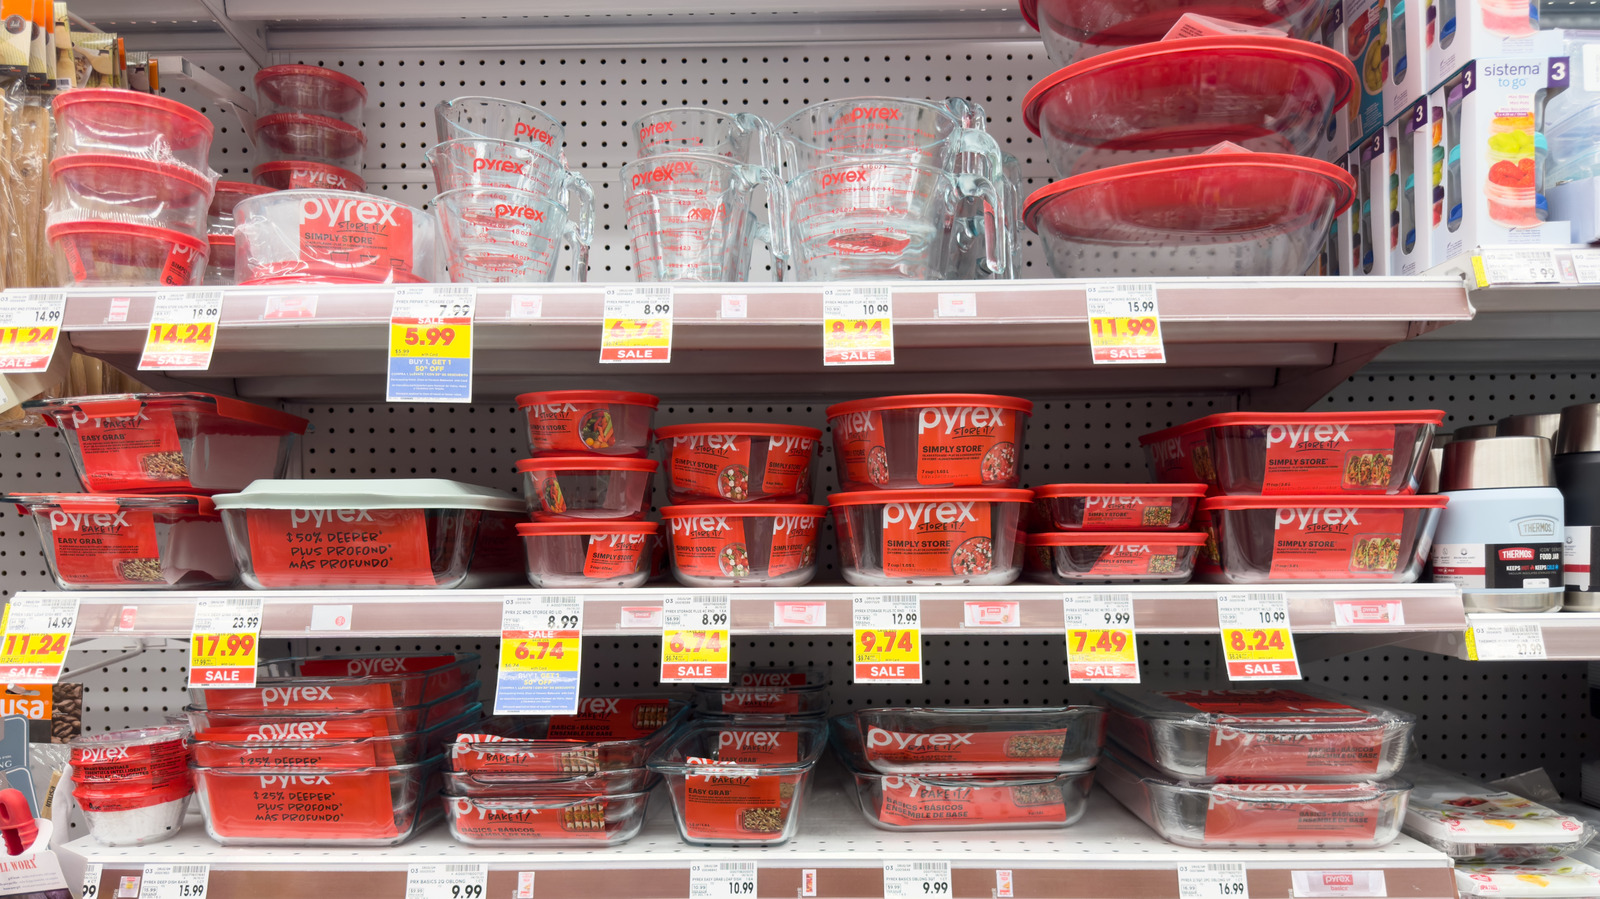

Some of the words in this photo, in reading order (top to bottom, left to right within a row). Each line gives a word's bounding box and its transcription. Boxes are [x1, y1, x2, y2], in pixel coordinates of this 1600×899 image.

[1484, 62, 1539, 77] sistema
[1552, 62, 1565, 81] 3
[1464, 70, 1472, 89] 3
[1498, 78, 1509, 87] to
[1512, 79, 1526, 89] go
[852, 107, 898, 122] pyrex
[1415, 105, 1423, 122] 3
[514, 122, 555, 147] pyrex
[640, 120, 673, 143] pyrex
[1373, 136, 1380, 152] 3
[473, 158, 524, 175] pyrex
[292, 170, 347, 189] pyrex
[632, 166, 674, 190] pyrex
[823, 170, 867, 189] pyrex
[301, 198, 398, 227] pyrex
[495, 204, 544, 223] pyrex
[305, 232, 339, 242] SIMPLY
[341, 234, 373, 245] STORE
[439, 304, 470, 317] 7.99
[644, 304, 670, 315] 8.99
[863, 304, 888, 315] 10.99
[1128, 301, 1154, 312] 15.99
[35, 310, 61, 322] 14.99
[418, 317, 445, 325] SALE
[154, 324, 212, 344] 14.24
[610, 321, 664, 339] 6.74
[832, 321, 883, 340] 8.24
[1093, 319, 1155, 337] 11.99
[0, 327, 54, 348] 11.24
[404, 327, 456, 346] 5.99
[157, 356, 193, 364] SALE
[618, 349, 652, 358] SALE
[841, 350, 875, 360] SALE
[1110, 349, 1146, 358] SALE
[0, 357, 32, 368] SALE
[919, 406, 1003, 434] pyrex
[953, 426, 980, 435] STORE
[982, 425, 995, 435] IT!
[1267, 424, 1350, 449] pyrex
[81, 434, 101, 442] EASY
[102, 433, 126, 441] GRAB
[673, 436, 737, 452] pyrex
[923, 445, 954, 454] SIMPLY
[956, 445, 982, 453] STORE
[675, 458, 696, 466] SIMPLY
[697, 461, 718, 470] STORE
[50, 510, 131, 531] pyrex
[291, 508, 374, 529] pyrex
[883, 502, 977, 530] pyrex
[1275, 507, 1359, 530] pyrex
[672, 516, 731, 536] pyrex
[918, 522, 947, 531] STORE
[949, 521, 964, 531] IT!
[1335, 523, 1348, 531] IT!
[79, 537, 103, 545] GRAB
[296, 532, 323, 543] 50%
[888, 540, 919, 548] SIMPLY
[921, 540, 951, 548] STORE
[1278, 540, 1307, 548] SIMPLY
[291, 546, 323, 556] PLUS
[676, 545, 695, 553] SIMPLY
[696, 545, 716, 553] STORE
[1502, 550, 1532, 559] THERMOS
[593, 552, 616, 560] SIMPLY
[289, 557, 316, 569] MÁS
[48, 618, 73, 628] 14.99
[233, 617, 259, 628] 23.99
[547, 615, 578, 629] 8.99
[702, 614, 727, 625] 8.99
[892, 613, 917, 625] 12.99
[1104, 612, 1130, 624] 9.99
[1260, 612, 1286, 623] 10.99
[528, 630, 554, 639] SALE
[1230, 630, 1285, 651] 8.24
[8, 635, 68, 656] 11.24
[195, 635, 255, 656] 17.99
[670, 632, 721, 652] 6.74
[861, 632, 913, 652] 9.74
[1074, 632, 1127, 652] 7.49
[515, 642, 564, 660] 6.74
[9, 668, 45, 677] SALE
[678, 665, 712, 676] SALE
[870, 666, 905, 676] SALE
[1085, 666, 1121, 676] SALE
[1245, 663, 1281, 674] SALE
[205, 670, 240, 681] SALE
[262, 686, 334, 706] pyrex
[1, 700, 45, 719] usa
[259, 721, 327, 737] pyrex
[719, 732, 780, 750] pyrex
[867, 728, 972, 750] pyrex
[81, 745, 128, 762] pyrex
[247, 757, 271, 766] 25%
[46, 786, 56, 809] imusa
[261, 792, 285, 801] 25%
[688, 787, 707, 795] EASY
[257, 803, 281, 813] PLUS
[885, 803, 932, 818] ENSEMBLE
[255, 811, 276, 822] MÁS
[1326, 876, 1350, 885] pyrex
[179, 885, 203, 897] 15.99
[451, 886, 482, 899] 9.99
[729, 883, 754, 895] 10.99
[923, 882, 948, 895] 9.99
[1219, 882, 1245, 895] 16.99
